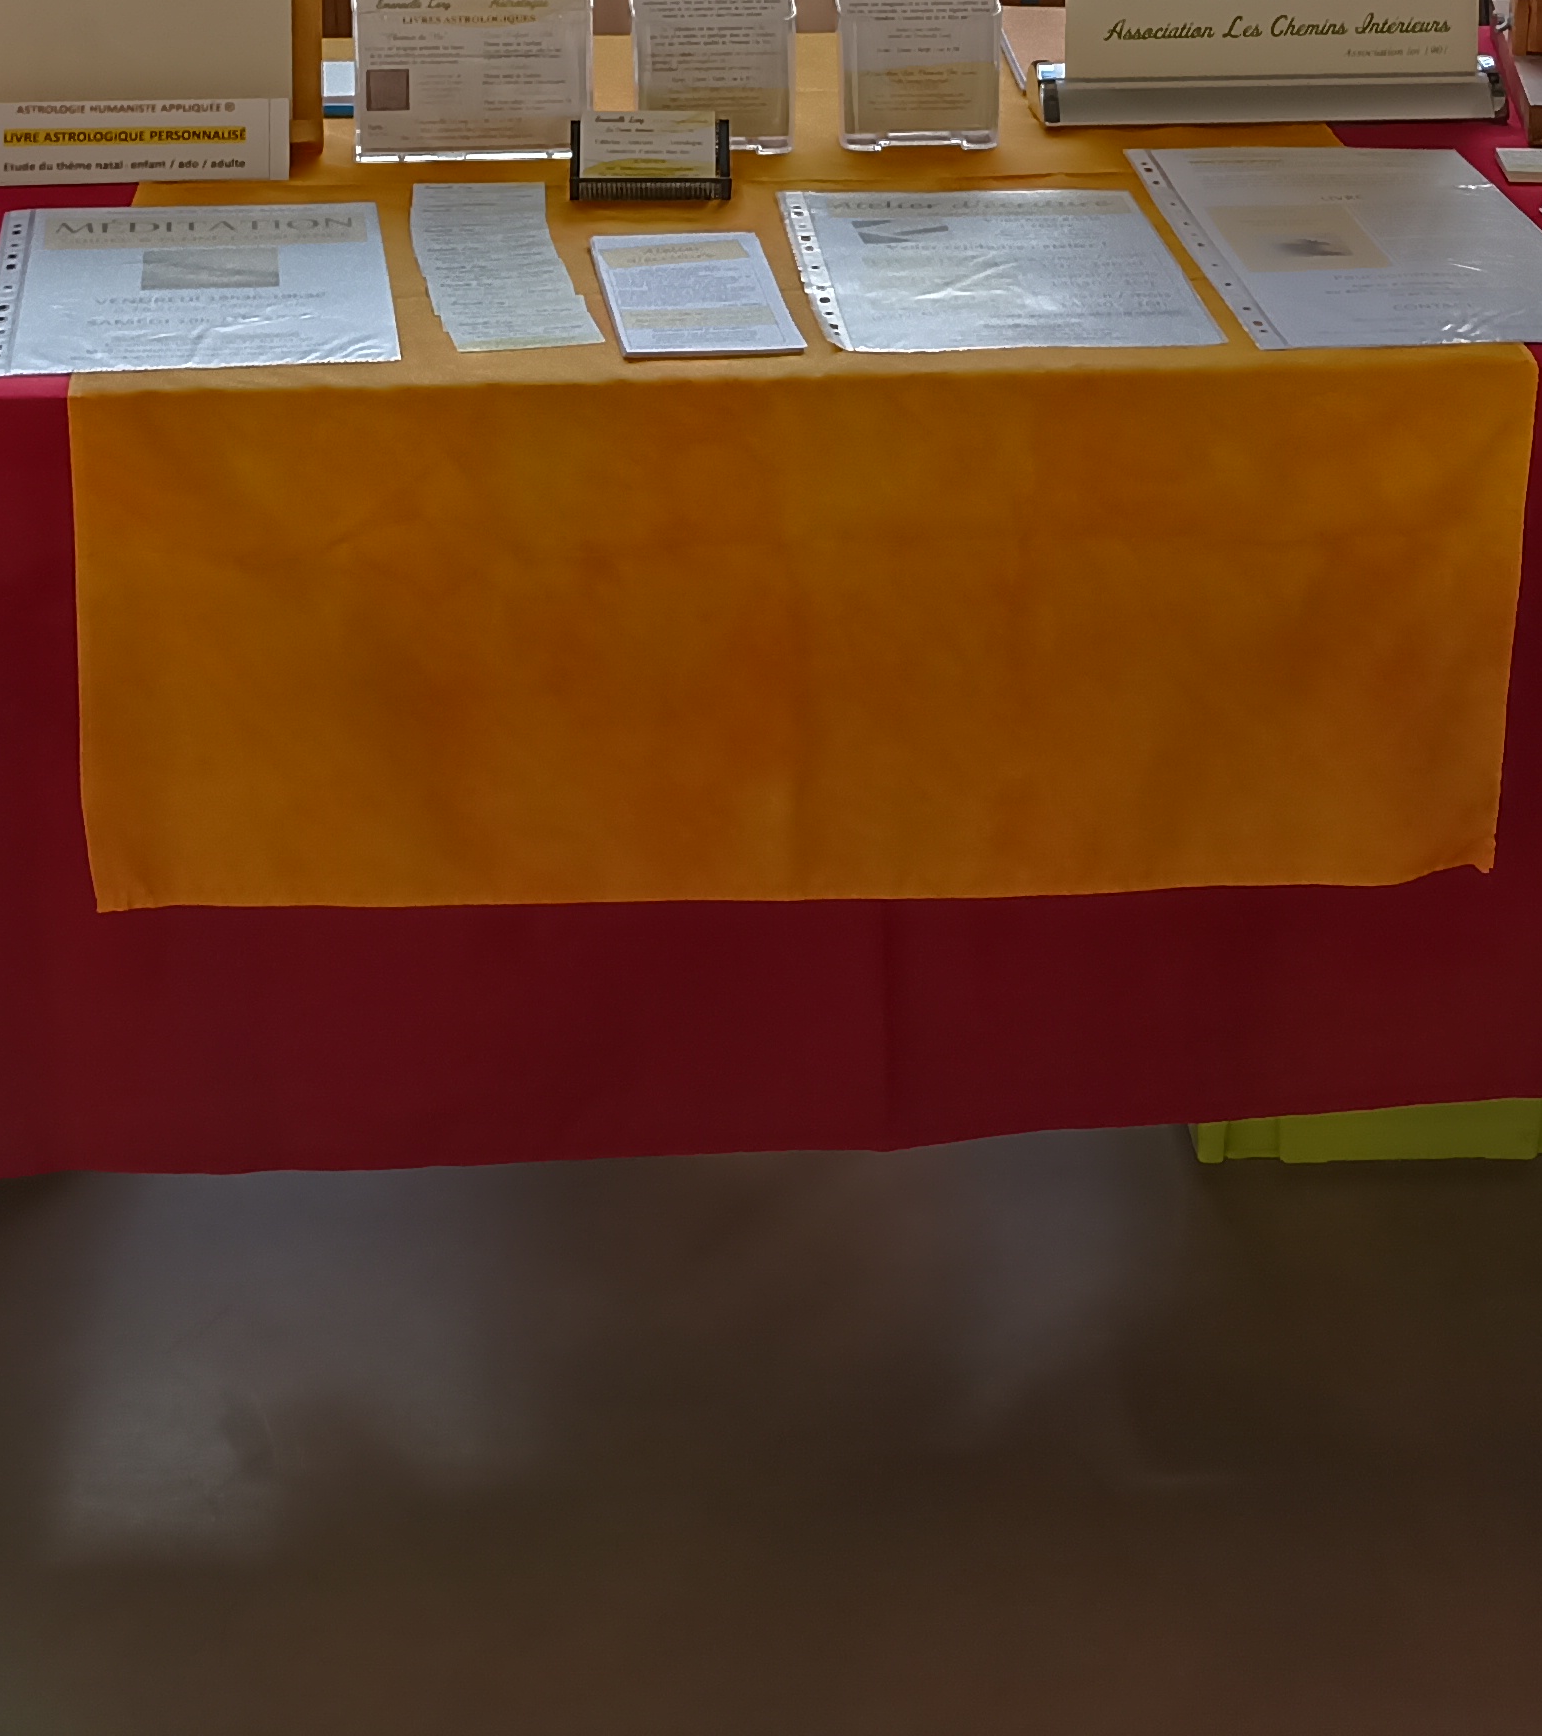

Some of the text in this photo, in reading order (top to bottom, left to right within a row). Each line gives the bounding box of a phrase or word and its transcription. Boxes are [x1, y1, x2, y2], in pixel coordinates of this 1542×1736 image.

[1103, 13, 1451, 42] Association Les Chemins Intérieurs
[4, 127, 246, 143] LIVRE ASTROLOGIQUE PERSONNALISÉ
[56, 217, 352, 234] MÉDITATION
